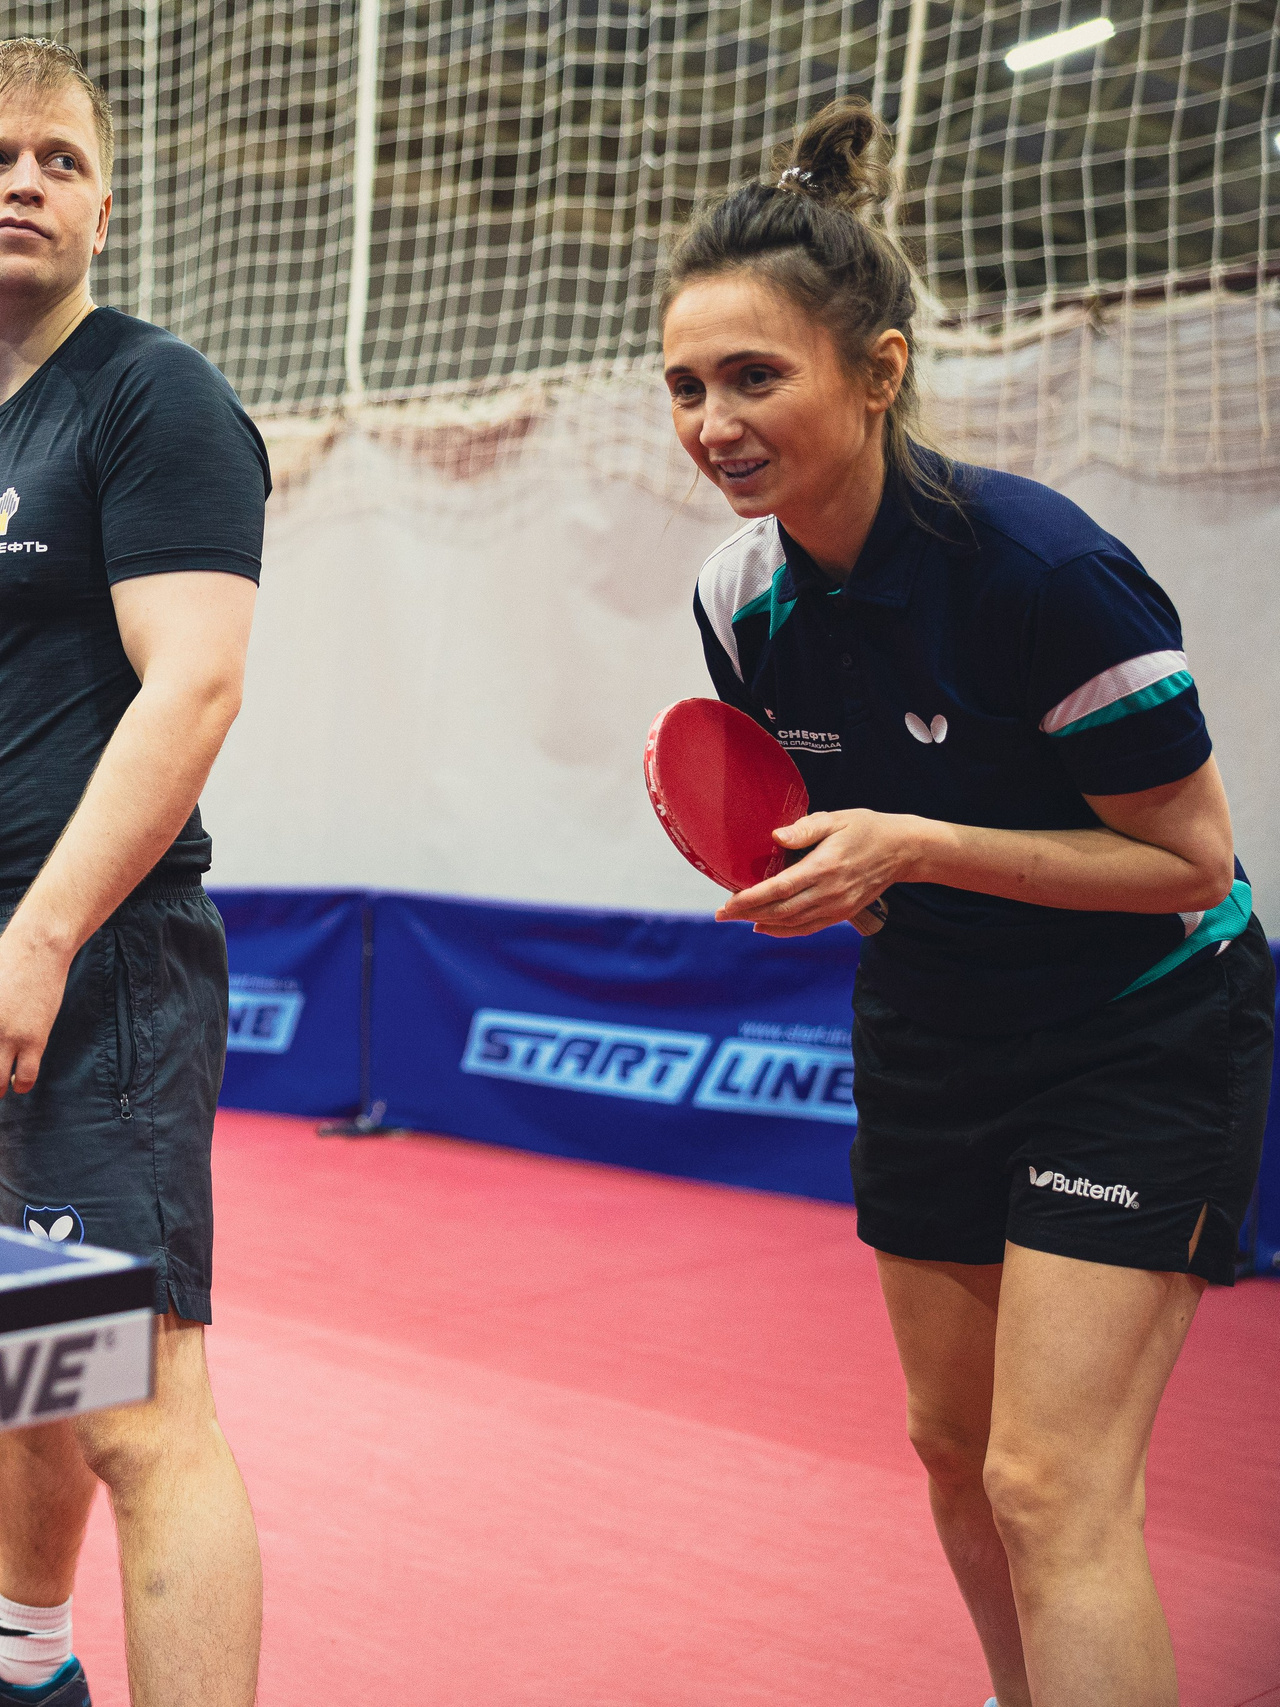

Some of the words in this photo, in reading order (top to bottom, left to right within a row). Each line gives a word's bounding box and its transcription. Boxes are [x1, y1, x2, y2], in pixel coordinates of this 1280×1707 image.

[777, 730, 840, 741] СНЕФТЬ
[484, 1028, 689, 1084] START
[718, 1057, 854, 1104] LINE
[1052, 1172, 1139, 1208] Butterfly
